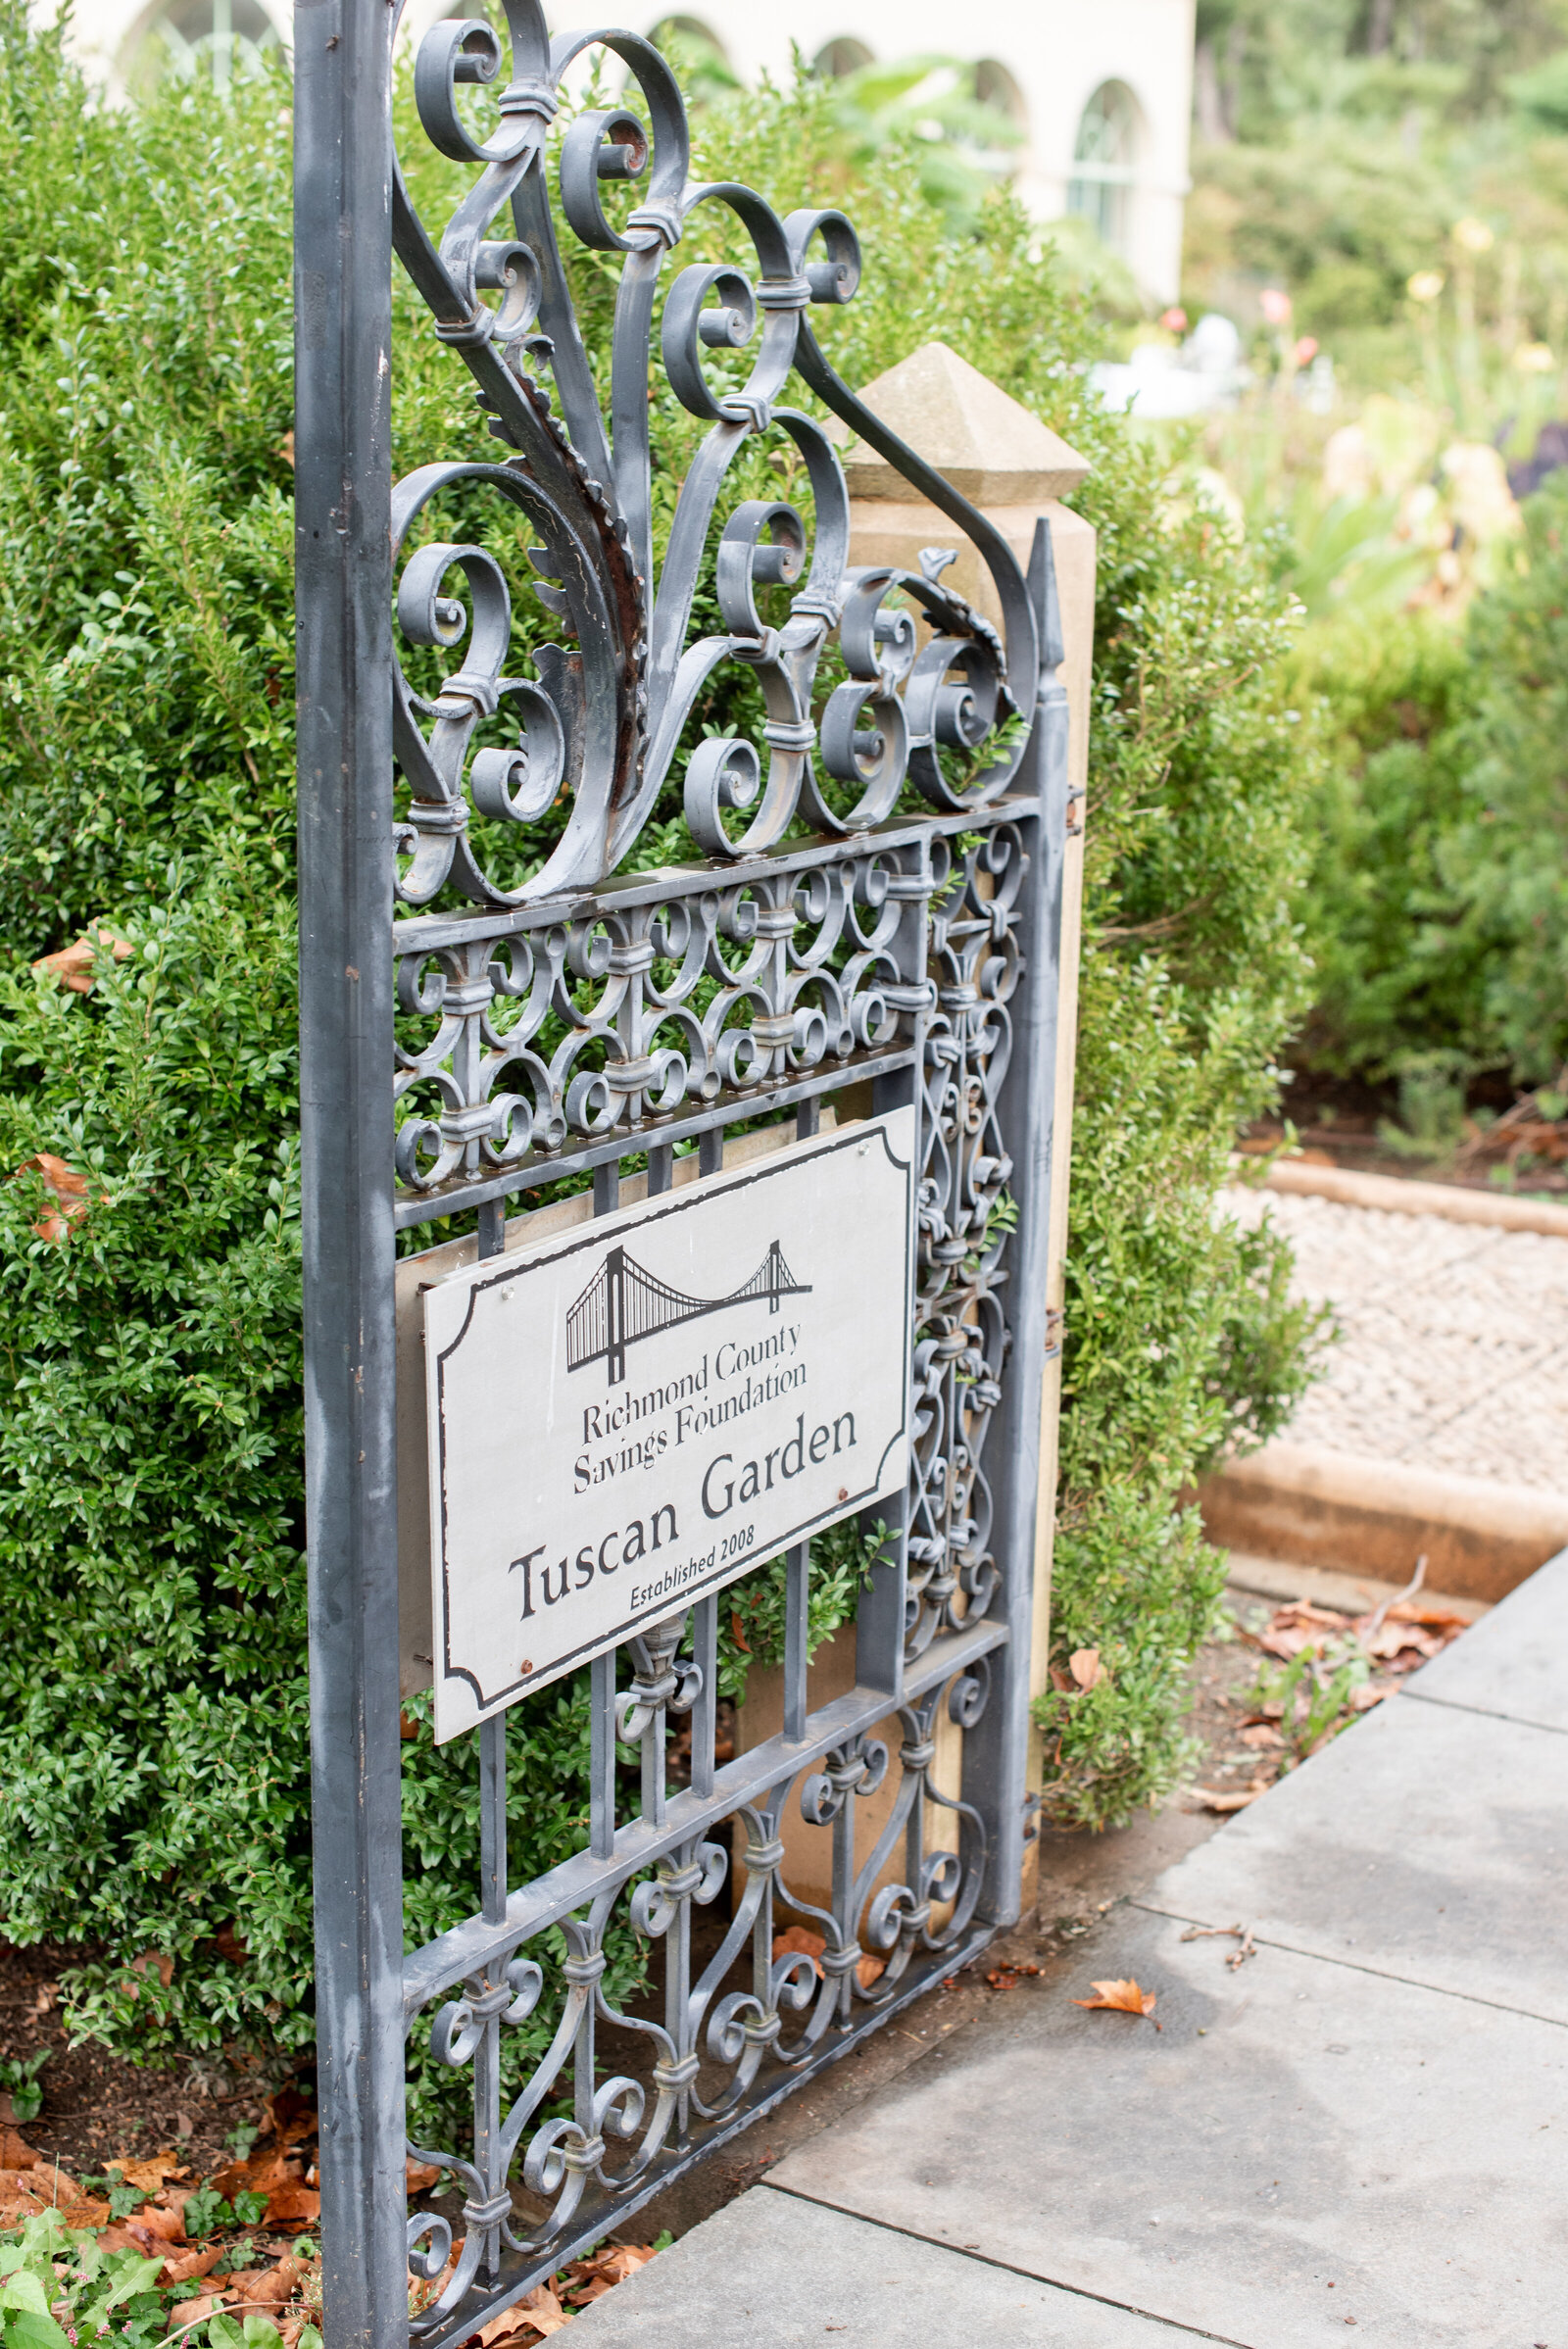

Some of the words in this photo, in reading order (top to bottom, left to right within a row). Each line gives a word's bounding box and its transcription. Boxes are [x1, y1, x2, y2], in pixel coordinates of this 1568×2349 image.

[574, 1428, 668, 1494] Savings
[674, 1361, 808, 1446] Foundation
[582, 1355, 708, 1445] Richmond
[715, 1323, 802, 1380] County
[509, 1503, 680, 1621] Tuscan
[701, 1411, 857, 1521] Garden
[630, 1543, 716, 1612] Established
[720, 1524, 756, 1562] 2008
